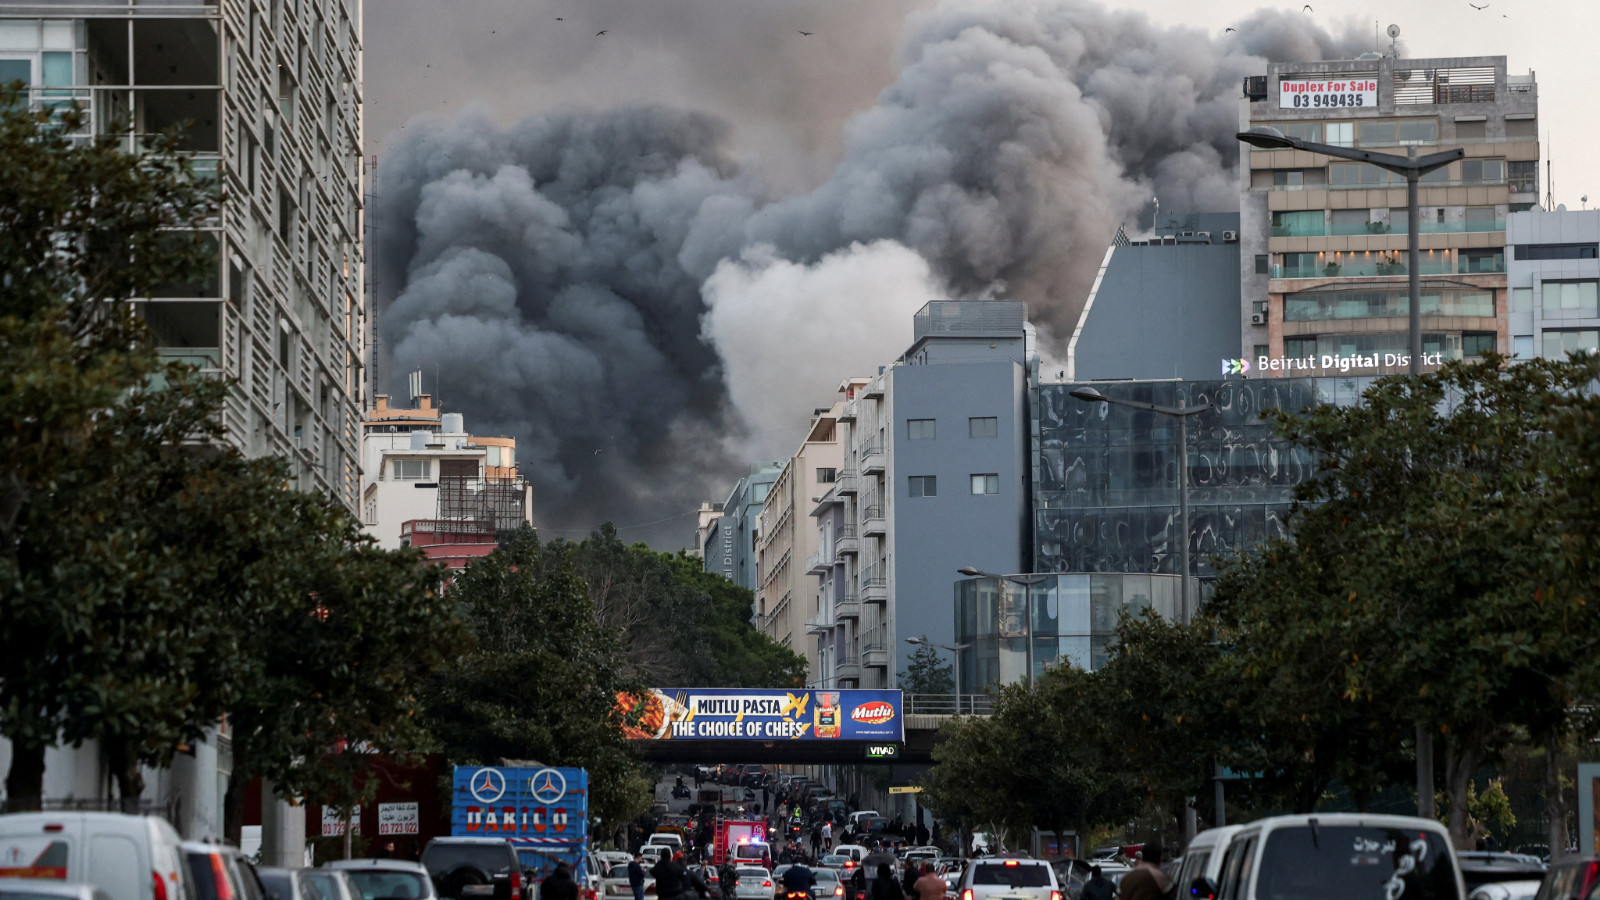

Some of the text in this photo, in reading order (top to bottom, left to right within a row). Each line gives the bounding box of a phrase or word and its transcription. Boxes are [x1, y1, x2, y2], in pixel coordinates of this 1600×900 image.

[1283, 80, 1376, 94] Duplex For Sale
[1293, 93, 1364, 108] 03 949435
[1258, 354, 1316, 371] Beirut
[1321, 352, 1379, 372] Digital
[723, 525, 732, 565] District
[698, 699, 781, 714] MUTLU PASTA
[851, 704, 892, 720] Mutlu
[672, 721, 803, 737] THE CHOICE OF CHEFS
[322, 823, 332, 834] 03
[380, 823, 389, 834] 03
[391, 823, 403, 833] 723
